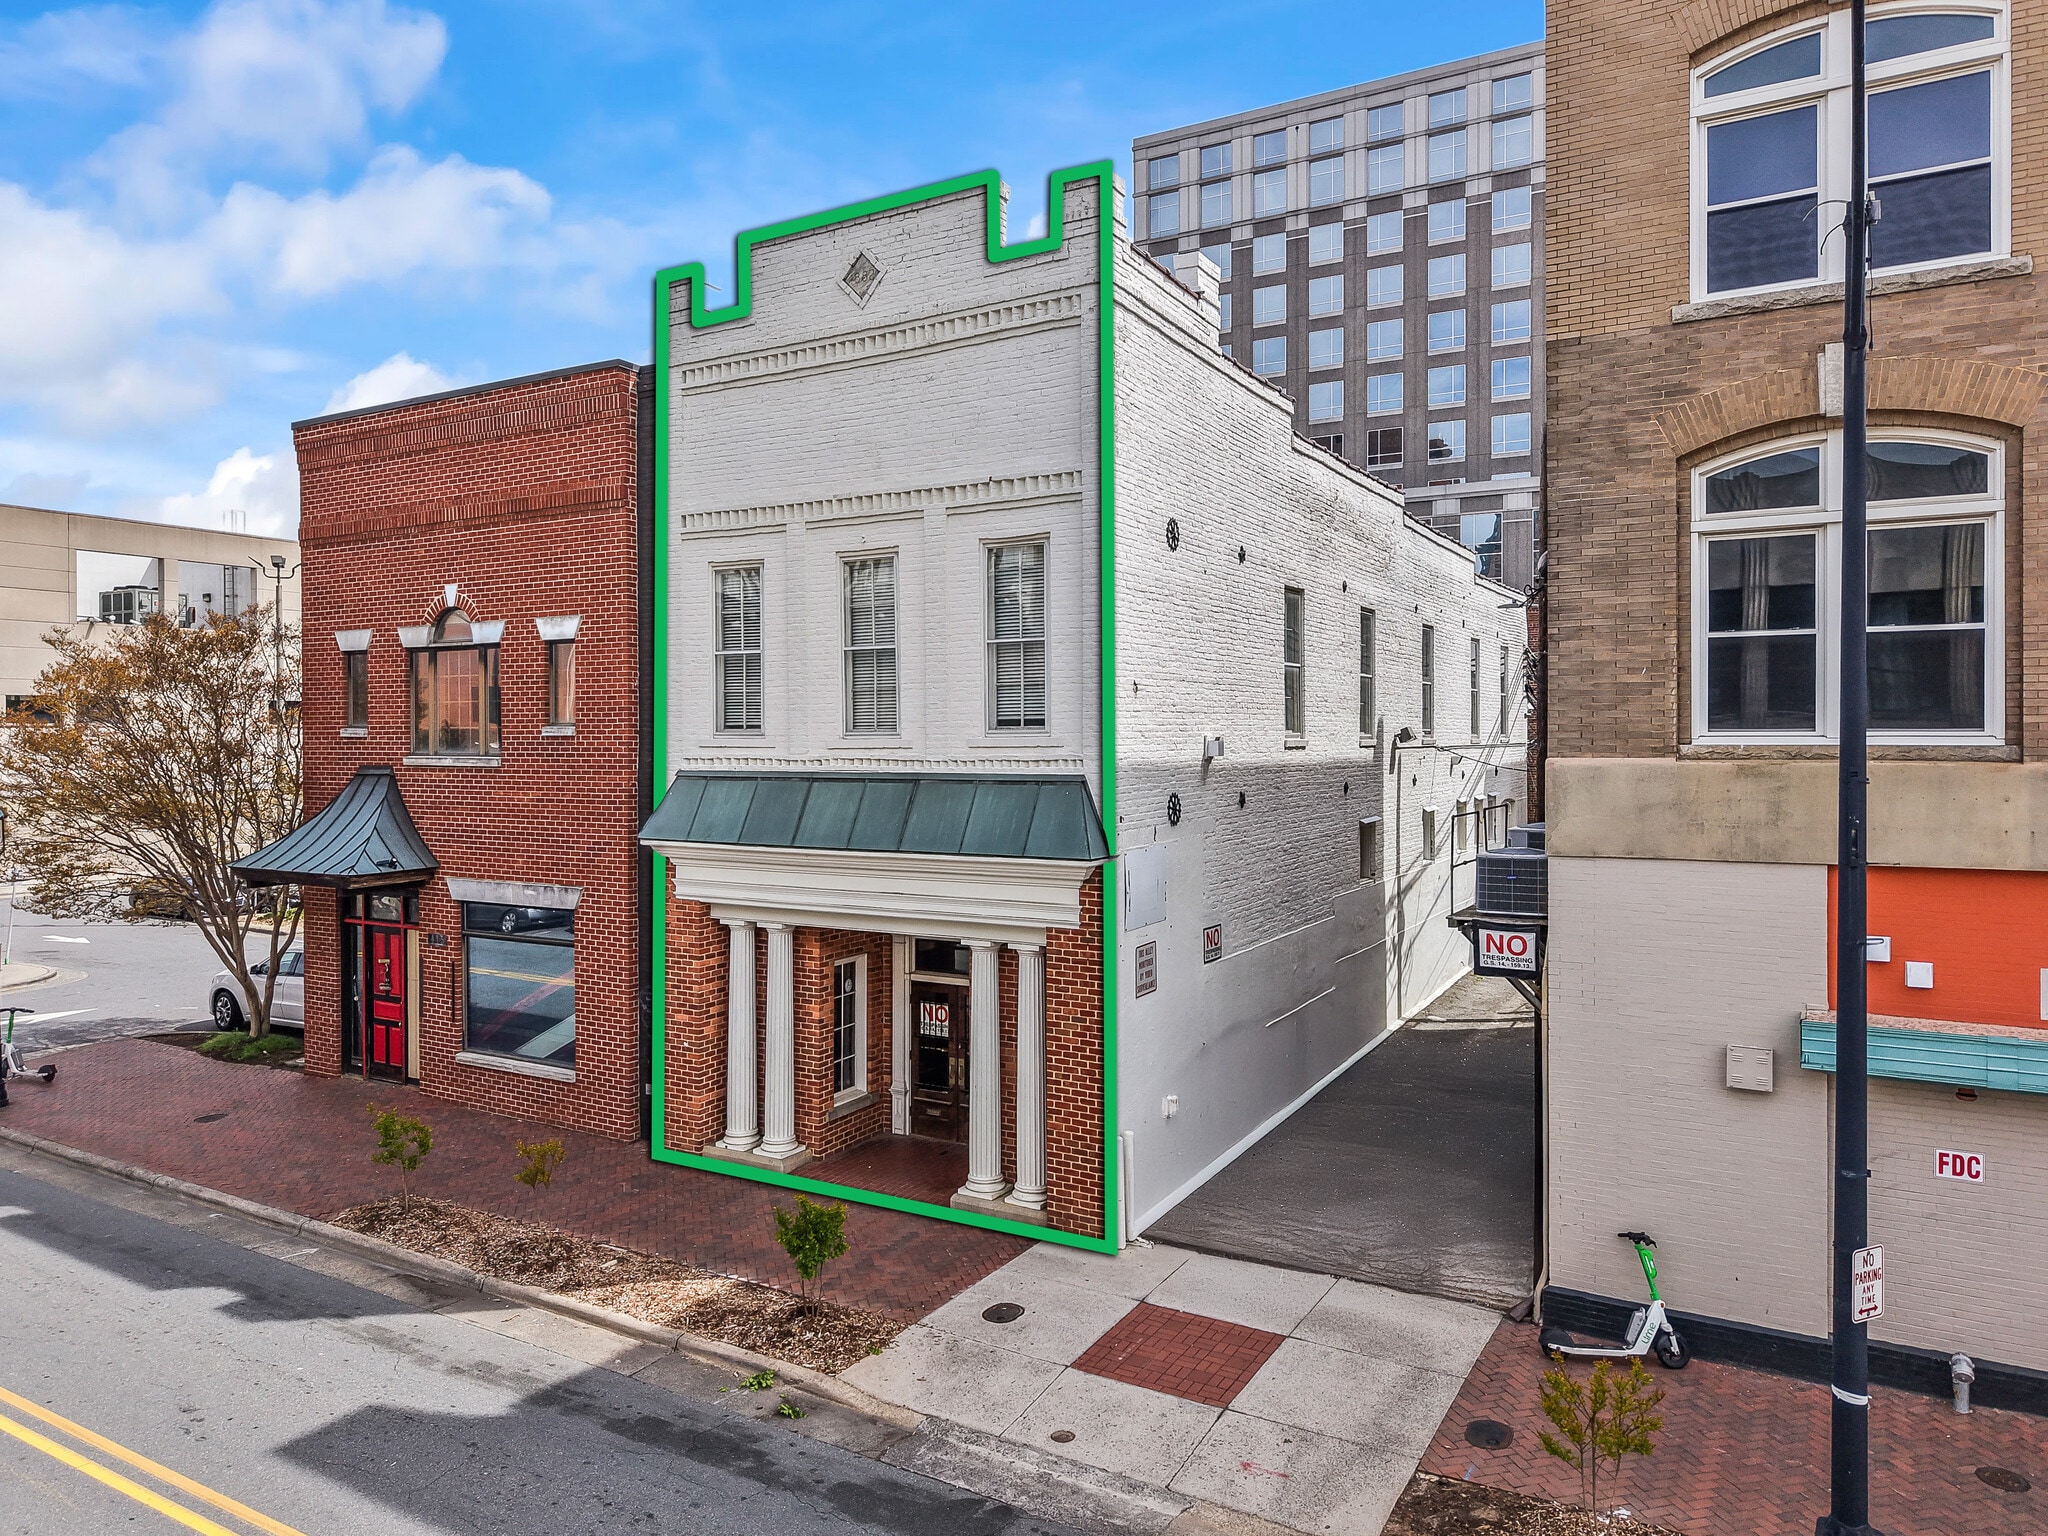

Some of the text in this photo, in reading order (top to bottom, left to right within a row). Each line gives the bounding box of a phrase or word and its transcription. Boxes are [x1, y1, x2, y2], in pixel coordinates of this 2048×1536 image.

[1206, 928, 1220, 949] NO
[1486, 933, 1528, 957] NO
[1481, 953, 1533, 964] TRESPASSING
[922, 1003, 949, 1024] NO
[1938, 1152, 1981, 1180] FDC
[1862, 1253, 1875, 1269] NO
[1855, 1267, 1882, 1286] PARKING
[1862, 1283, 1875, 1295] ANY
[1861, 1294, 1876, 1306] TIME
